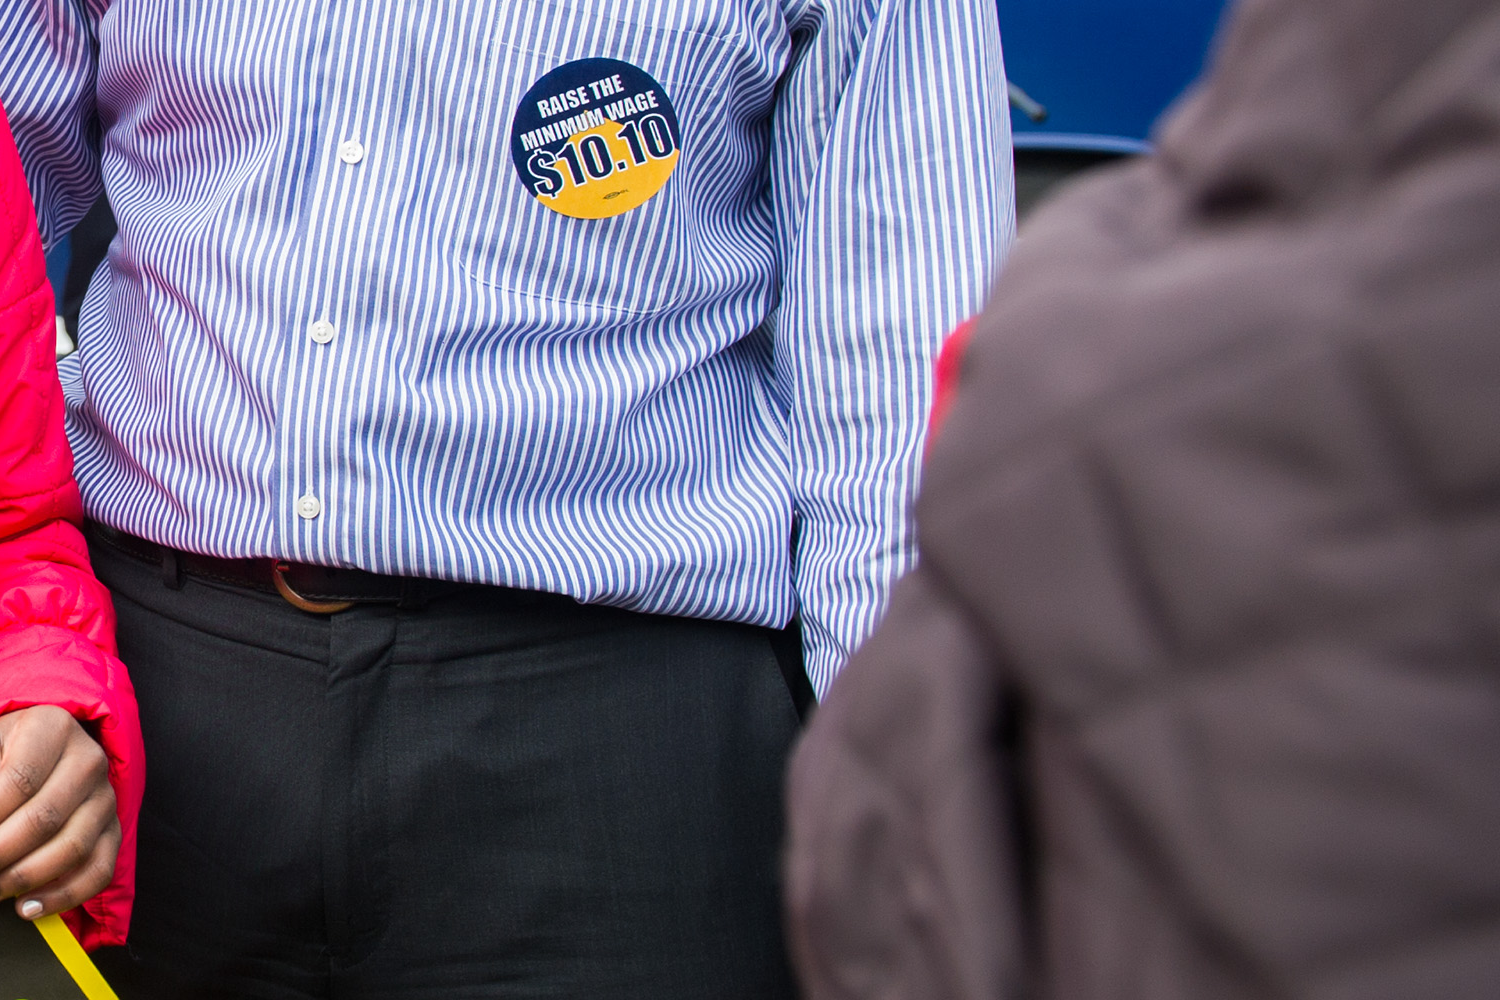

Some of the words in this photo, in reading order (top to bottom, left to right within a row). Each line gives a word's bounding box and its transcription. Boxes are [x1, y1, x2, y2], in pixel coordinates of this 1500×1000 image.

[520, 107, 606, 151] MINIMUM
[604, 90, 659, 121] WAGE
[536, 85, 590, 119] RAISE
[589, 74, 625, 100] THE
[526, 112, 676, 199] $10.10
